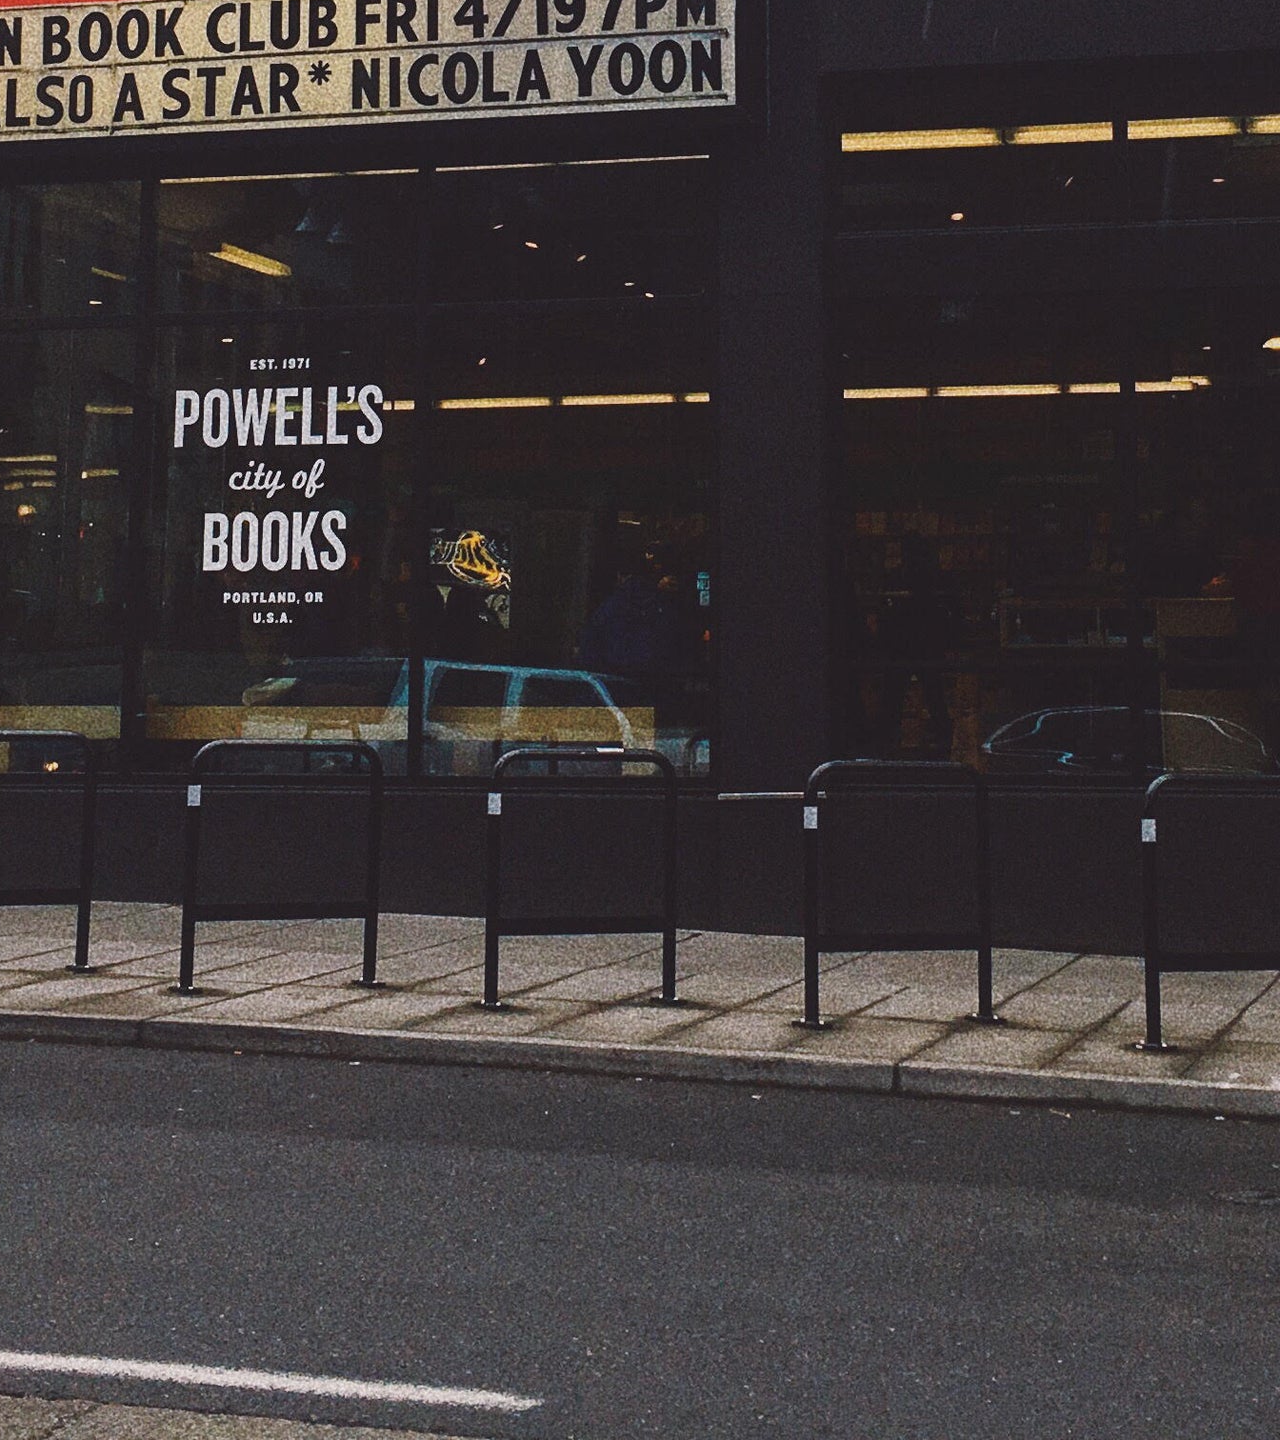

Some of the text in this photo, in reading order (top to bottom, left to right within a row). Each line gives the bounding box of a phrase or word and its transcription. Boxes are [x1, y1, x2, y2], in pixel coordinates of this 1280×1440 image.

[43, 7, 184, 66] BOOK
[113, 73, 145, 124] A
[351, 49, 550, 111] NICOLA
[567, 38, 724, 97] YOON
[250, 358, 311, 370] EST. 1971
[174, 385, 383, 448] POWELL'S
[229, 459, 325, 498] city of
[203, 510, 347, 572] BOOKS
[223, 591, 324, 605] PORTLAND, OR
[253, 612, 293, 624] U.S.A.
